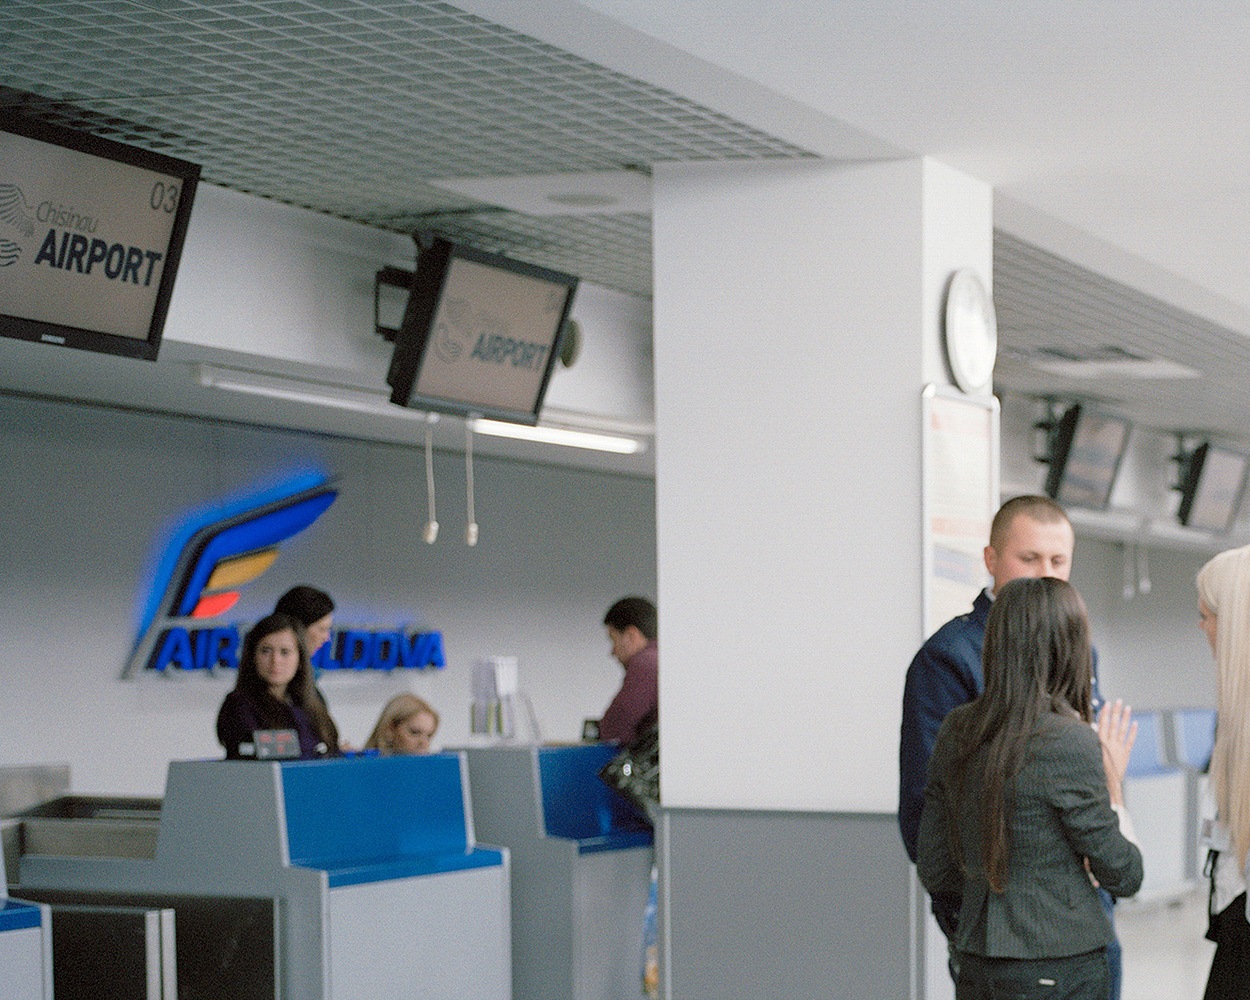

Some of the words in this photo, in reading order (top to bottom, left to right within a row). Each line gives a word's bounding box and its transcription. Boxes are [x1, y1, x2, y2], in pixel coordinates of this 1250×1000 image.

[151, 181, 178, 213] 03
[34, 228, 162, 286] AIRPORT
[470, 333, 551, 371] AIRPORT
[150, 626, 240, 670] AIR
[310, 629, 445, 670] LDOVA
